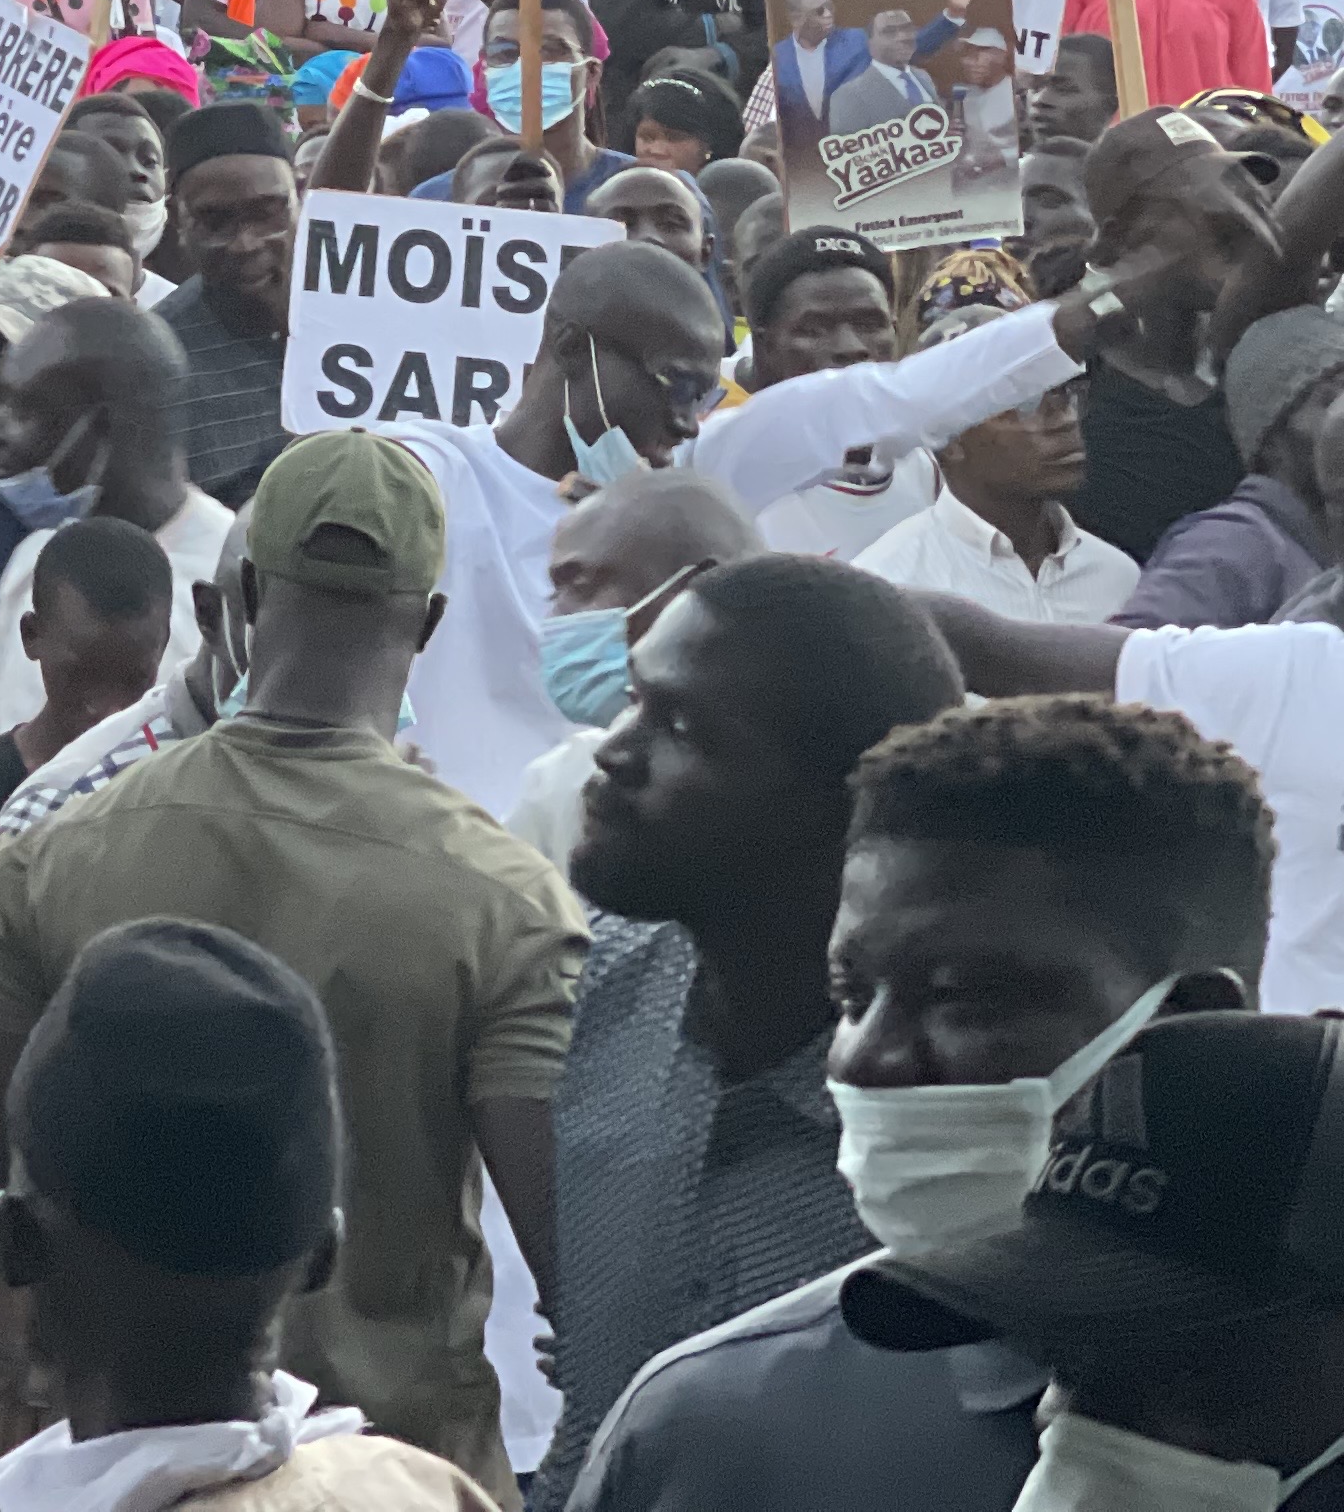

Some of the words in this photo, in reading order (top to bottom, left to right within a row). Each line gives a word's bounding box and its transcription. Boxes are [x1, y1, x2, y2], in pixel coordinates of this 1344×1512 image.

[823, 121, 904, 161] Benno
[831, 138, 960, 192] Yaakaar
[317, 343, 533, 427] SAR
[1033, 1141, 1169, 1215] idas
